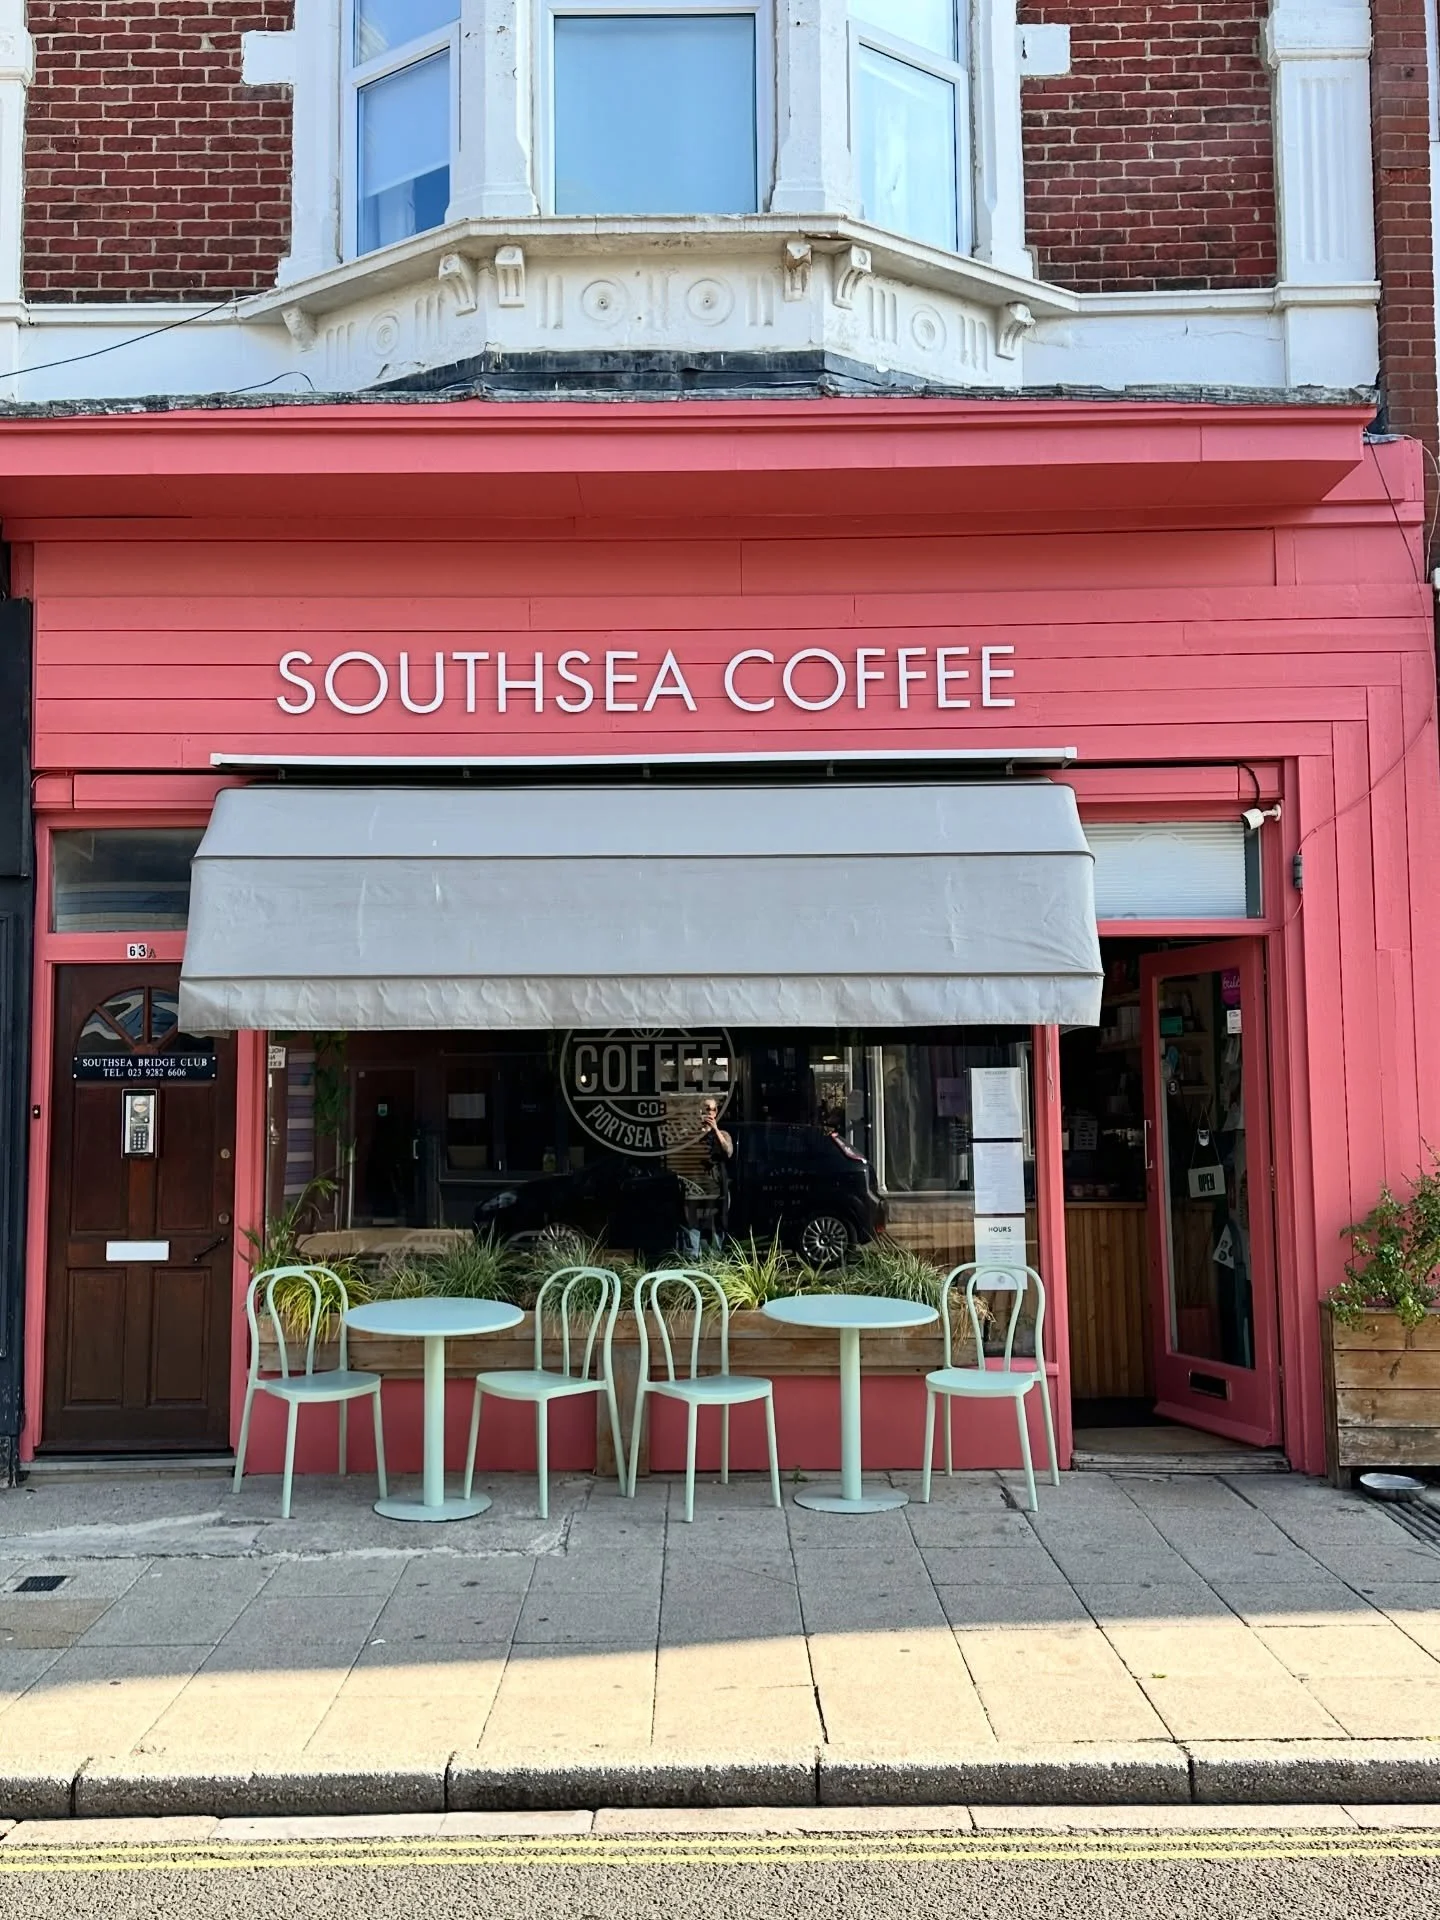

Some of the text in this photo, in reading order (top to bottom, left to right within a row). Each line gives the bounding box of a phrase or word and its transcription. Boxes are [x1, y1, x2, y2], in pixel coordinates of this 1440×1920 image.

[276, 645, 1016, 715] SOUTHSEA COFFEE
[82, 1058, 208, 1067] SOUTHSEA BRIDGE CLUB
[128, 1068, 142, 1077] 023
[145, 1068, 164, 1077] 9282
[167, 1068, 187, 1077] 6606
[575, 1043, 721, 1093] COFFEE
[585, 1104, 653, 1148] PORTSEA
[1197, 1173, 1216, 1193] OPEN
